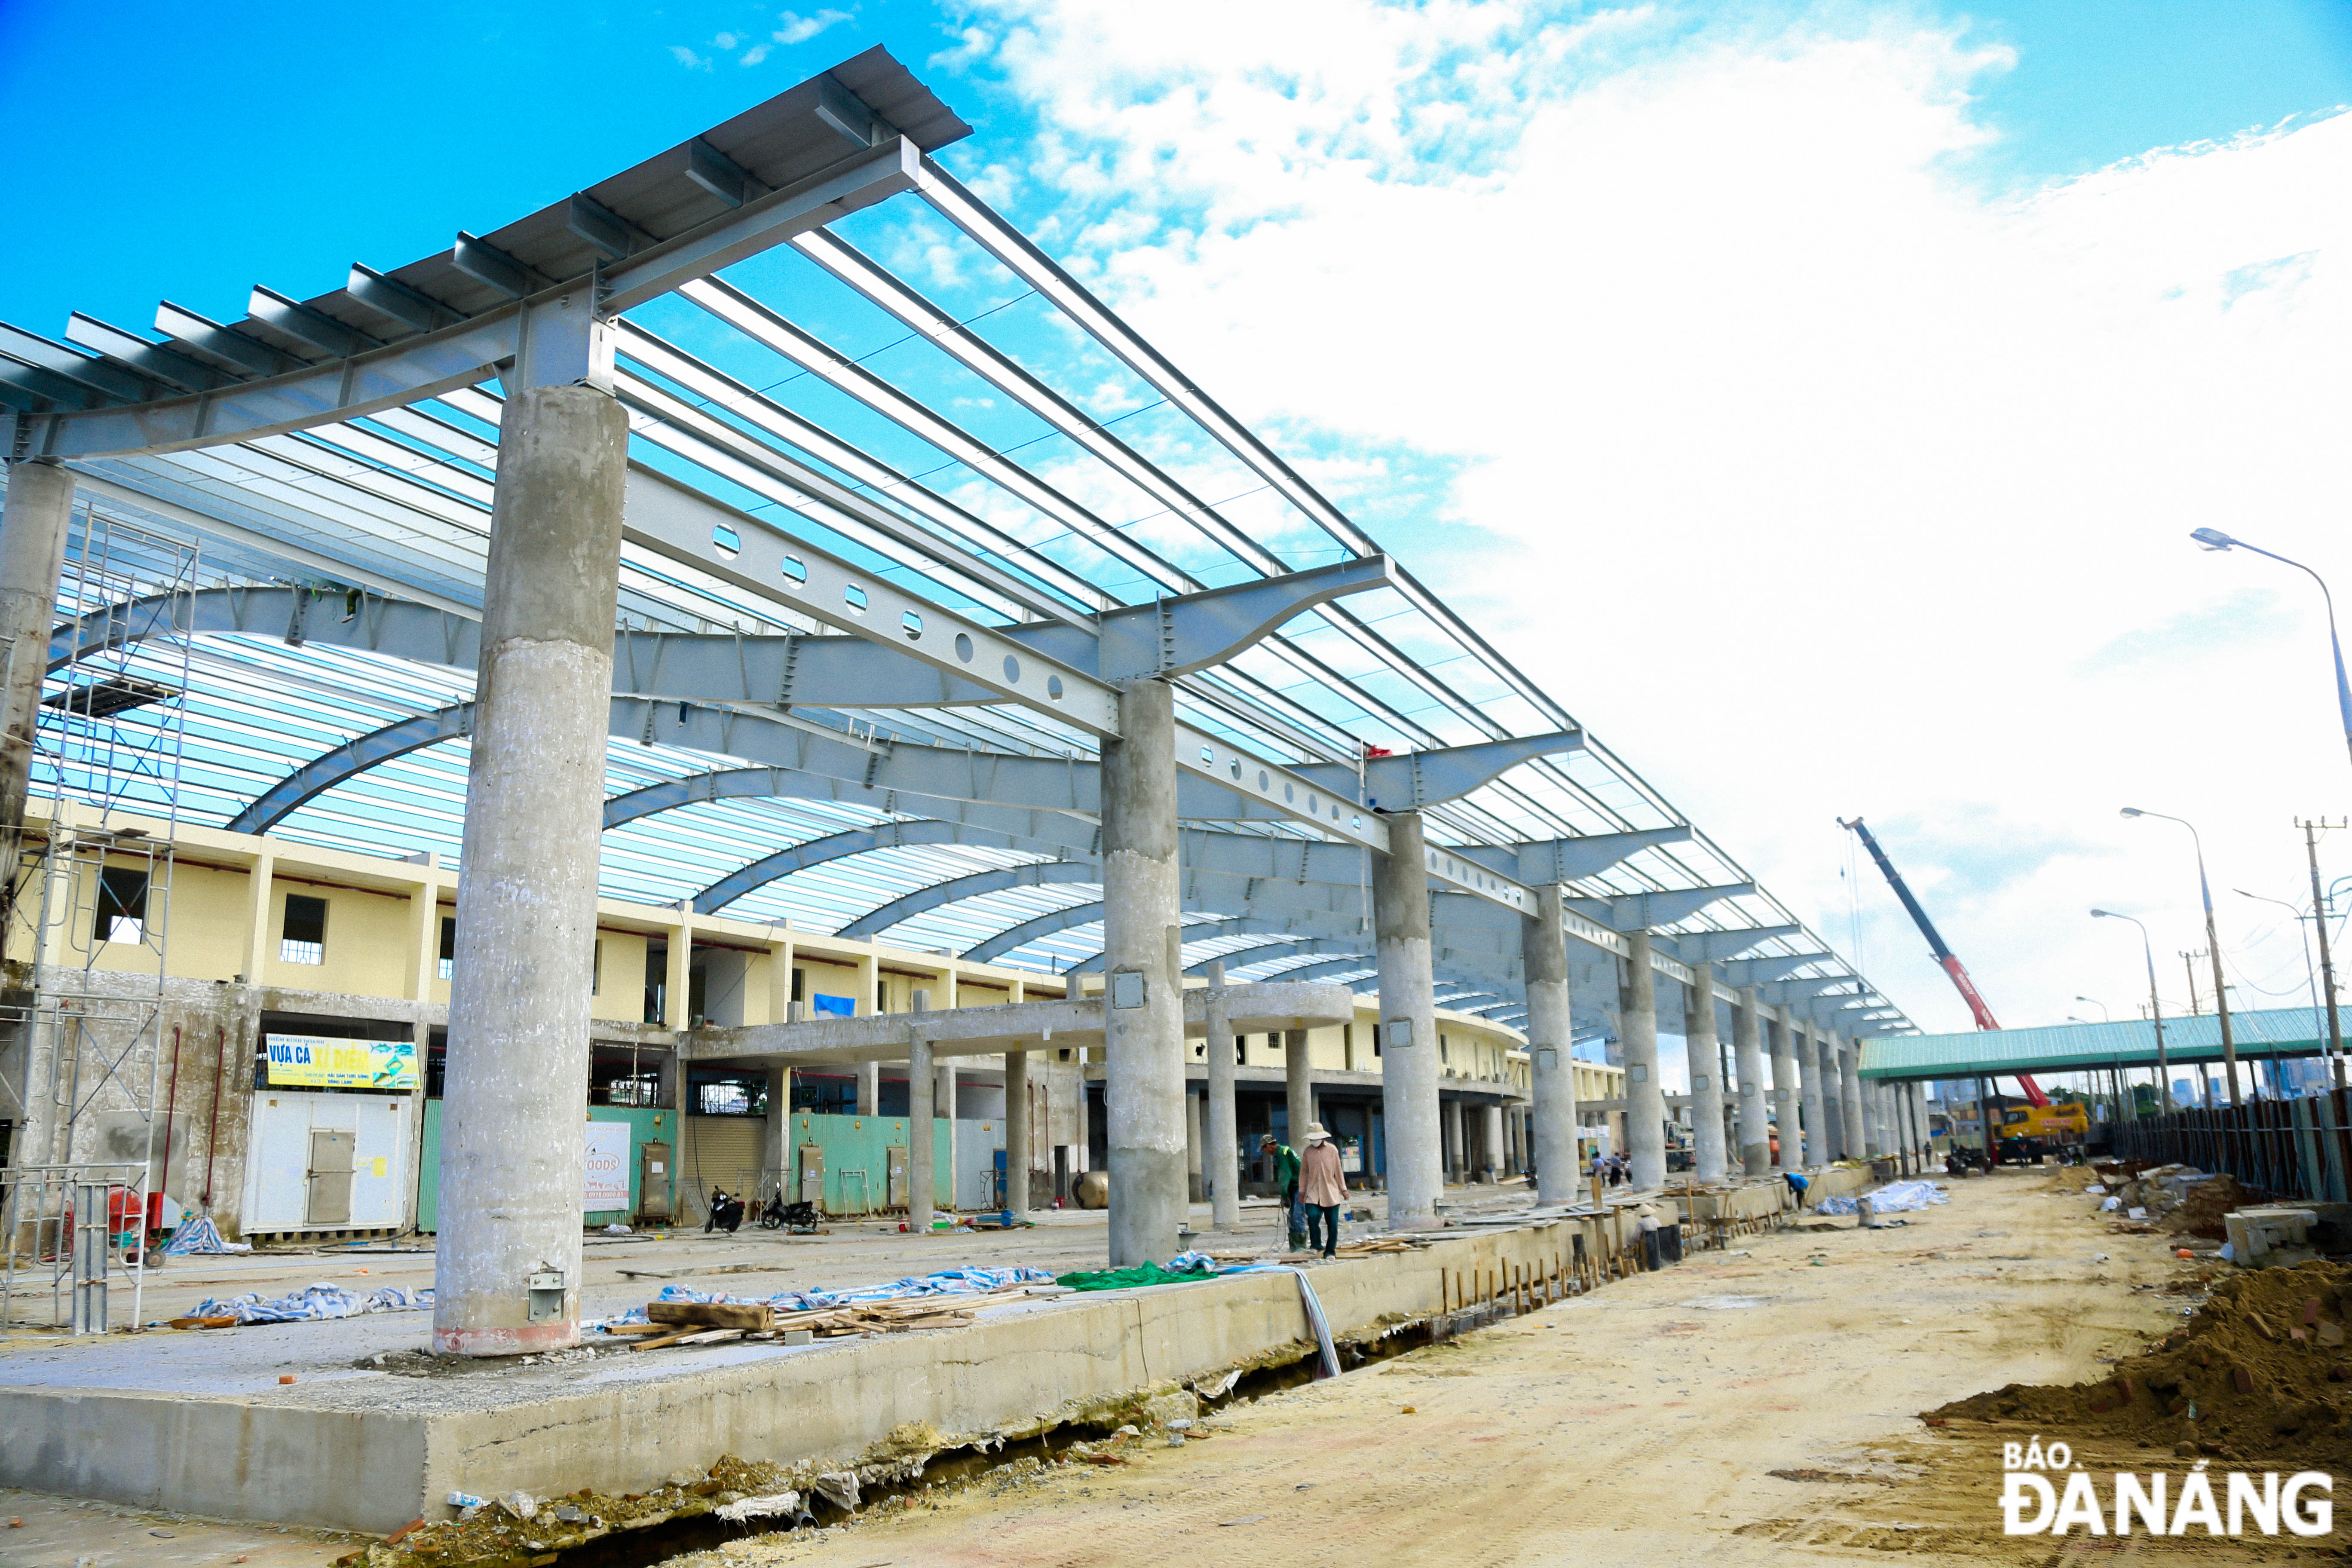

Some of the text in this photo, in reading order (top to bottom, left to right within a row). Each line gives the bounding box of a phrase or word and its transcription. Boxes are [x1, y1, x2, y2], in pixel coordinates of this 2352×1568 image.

[269, 1044, 293, 1066] VỰA
[296, 1043, 311, 1064] CÁ
[585, 1159, 617, 1170] OODS
